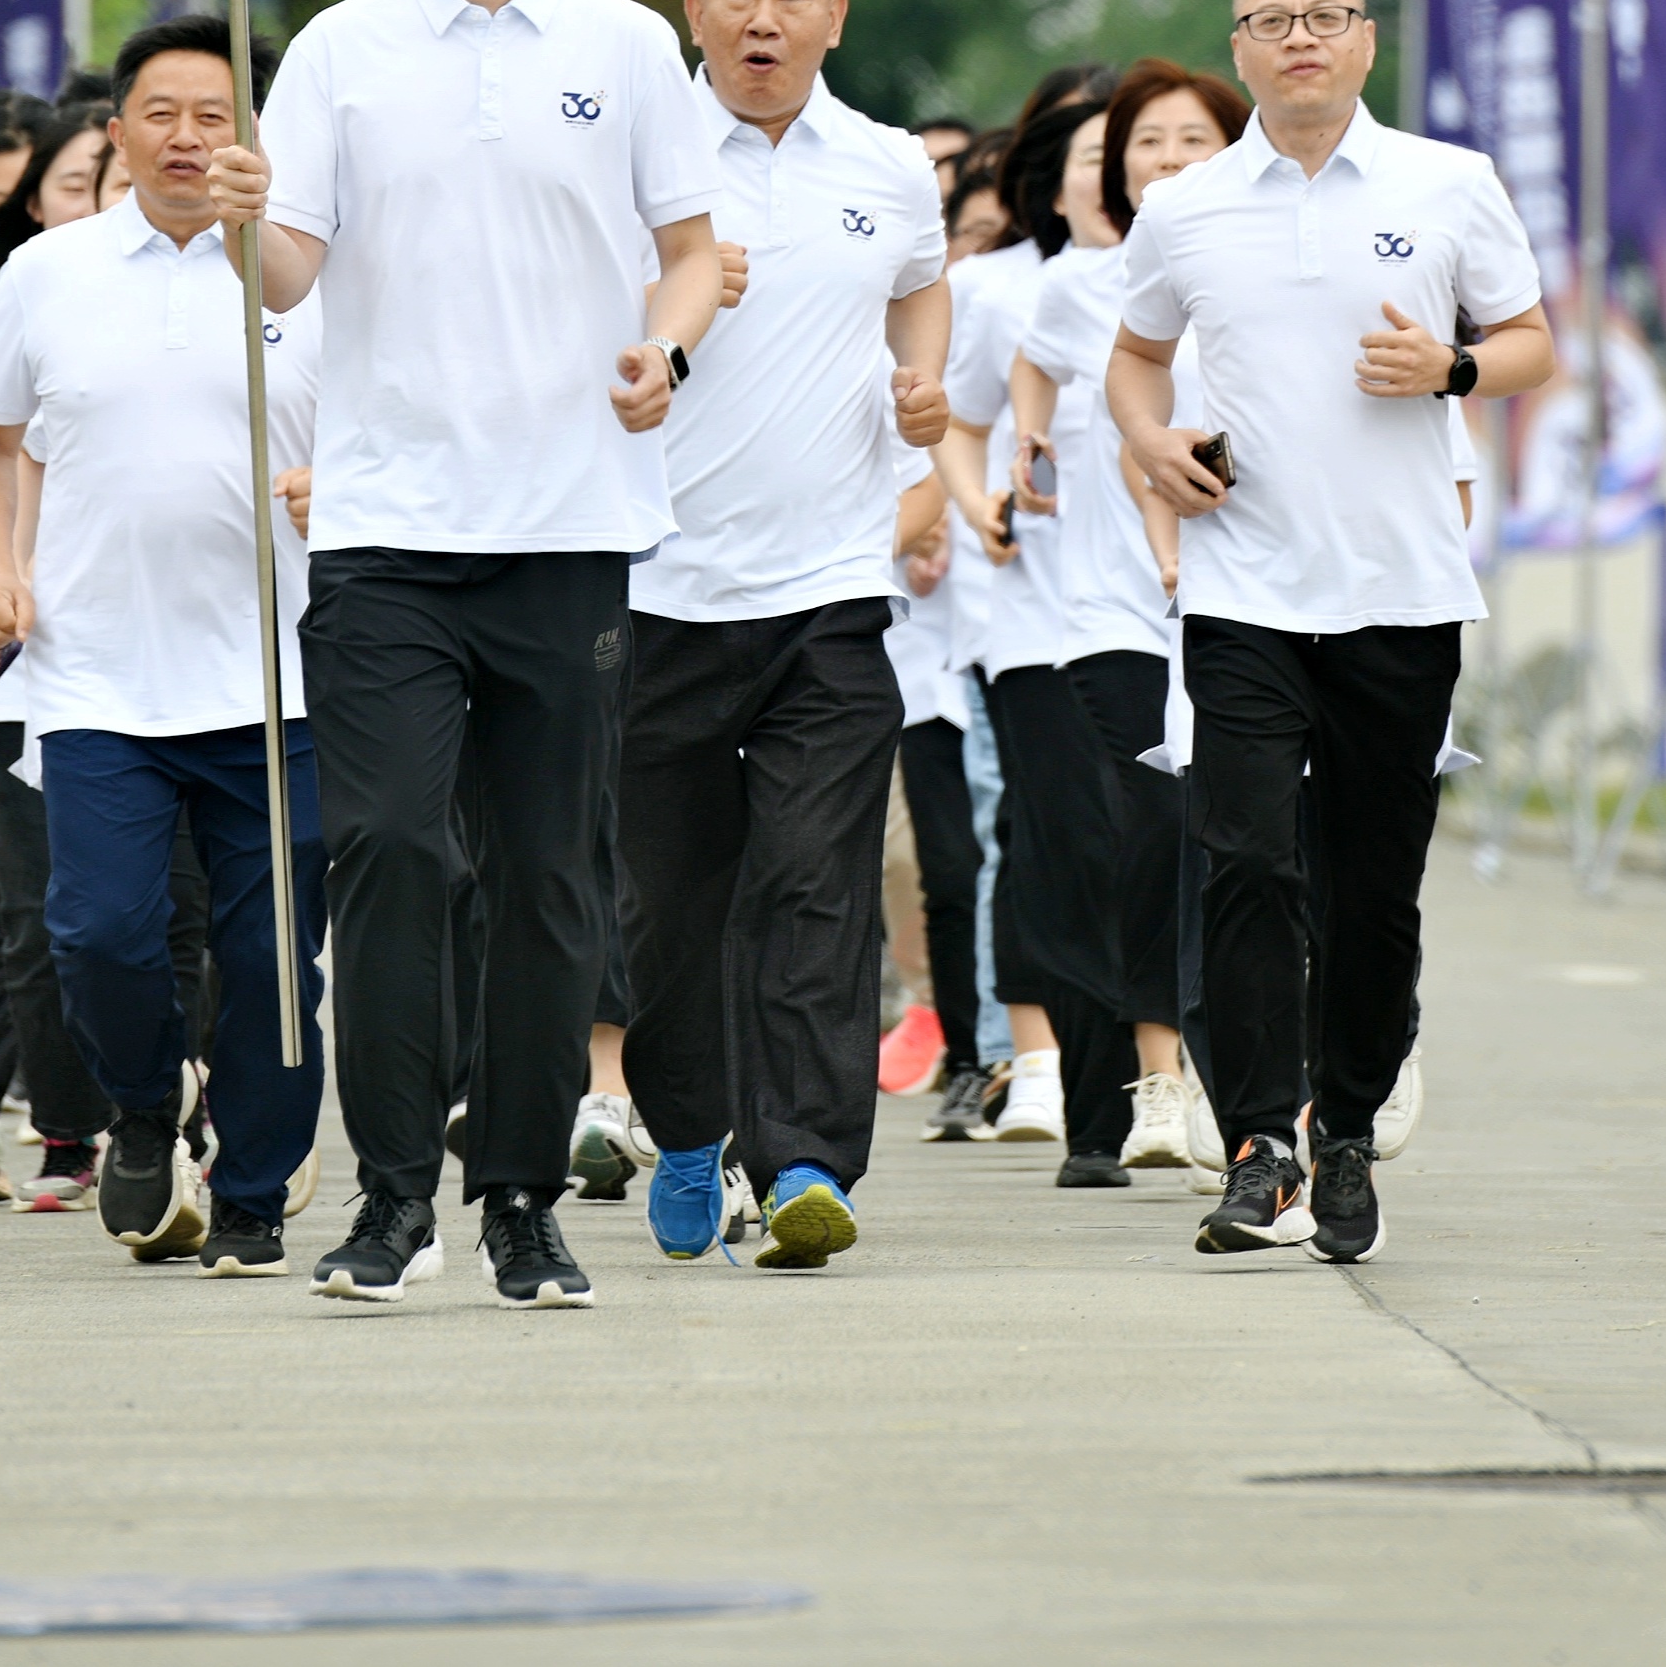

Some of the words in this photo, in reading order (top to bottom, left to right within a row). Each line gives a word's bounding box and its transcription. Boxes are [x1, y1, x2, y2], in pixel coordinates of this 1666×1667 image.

[561, 91, 602, 121] 30
[842, 207, 876, 237] 30
[1374, 232, 1415, 259] 30
